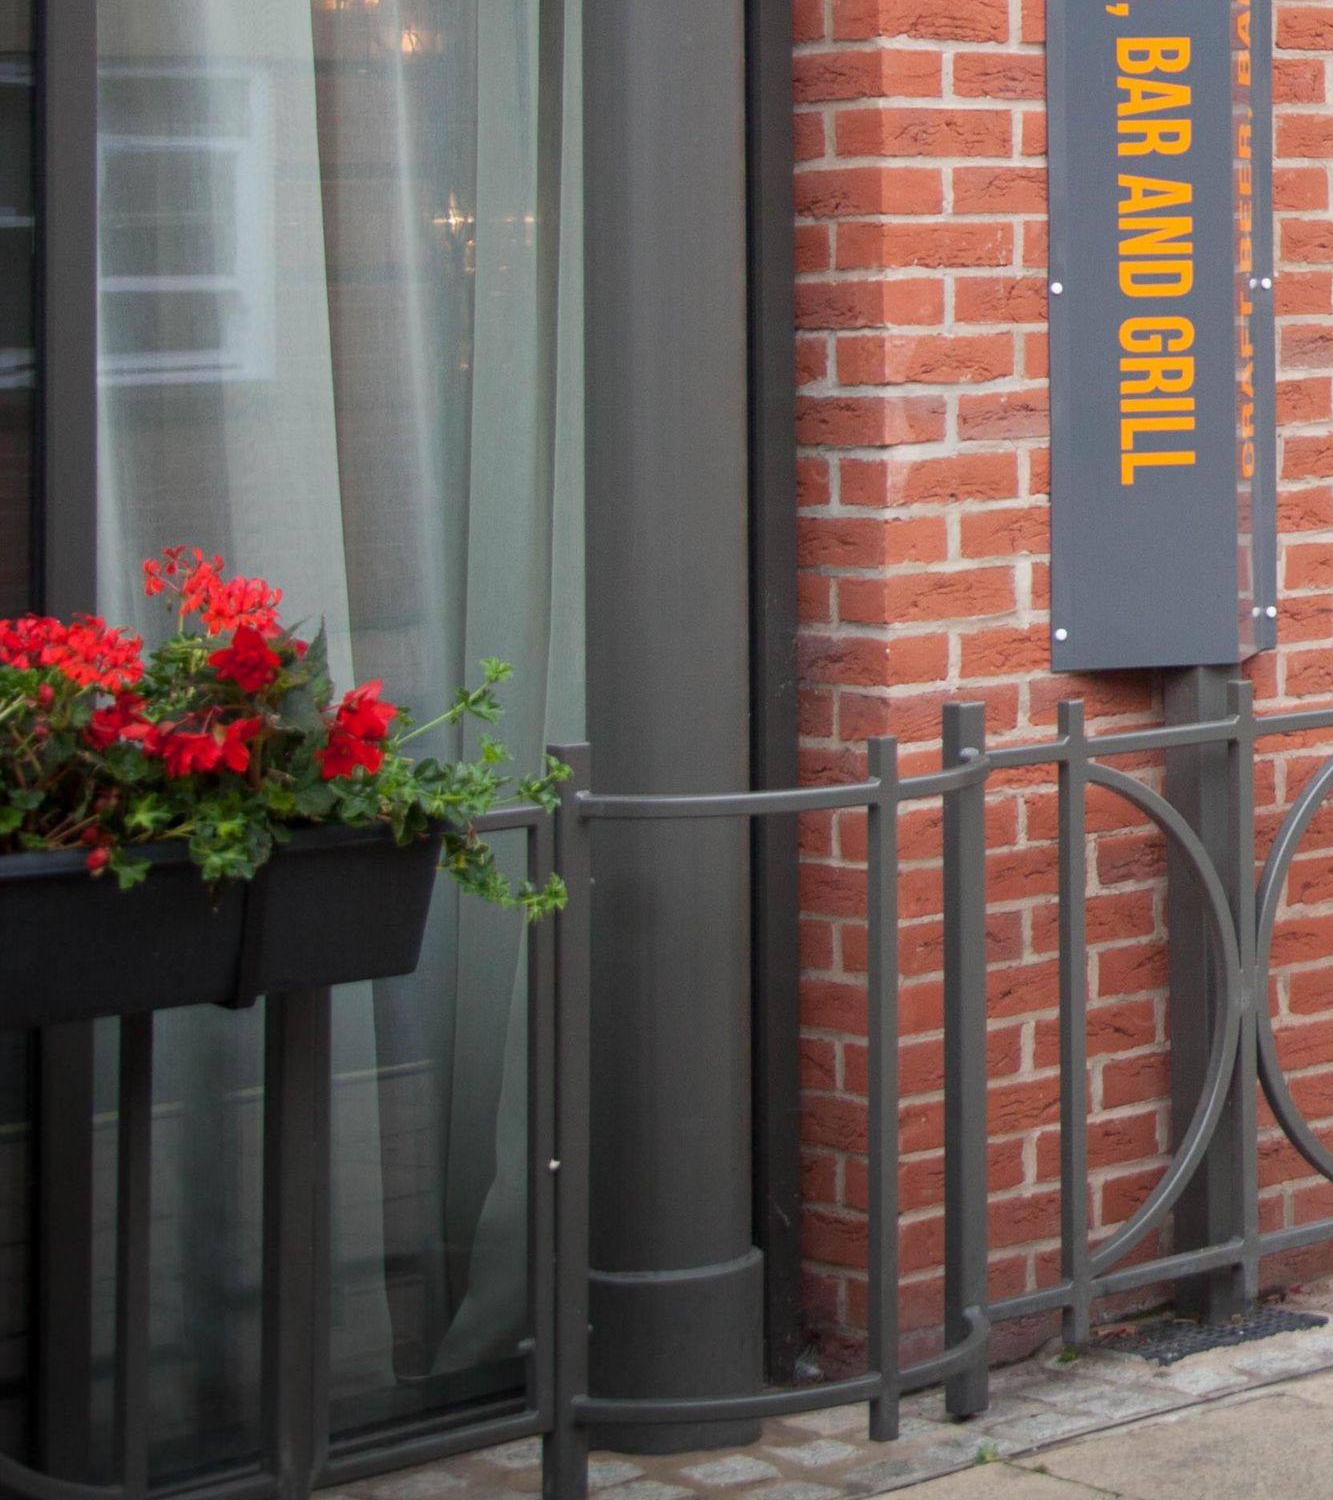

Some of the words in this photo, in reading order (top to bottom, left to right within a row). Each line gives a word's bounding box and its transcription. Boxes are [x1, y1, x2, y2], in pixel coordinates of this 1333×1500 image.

[1115, 36, 1192, 157] BAR
[1117, 172, 1193, 299] AND
[1118, 315, 1196, 486] GRILL
[1238, 291, 1254, 479] CRAFT
